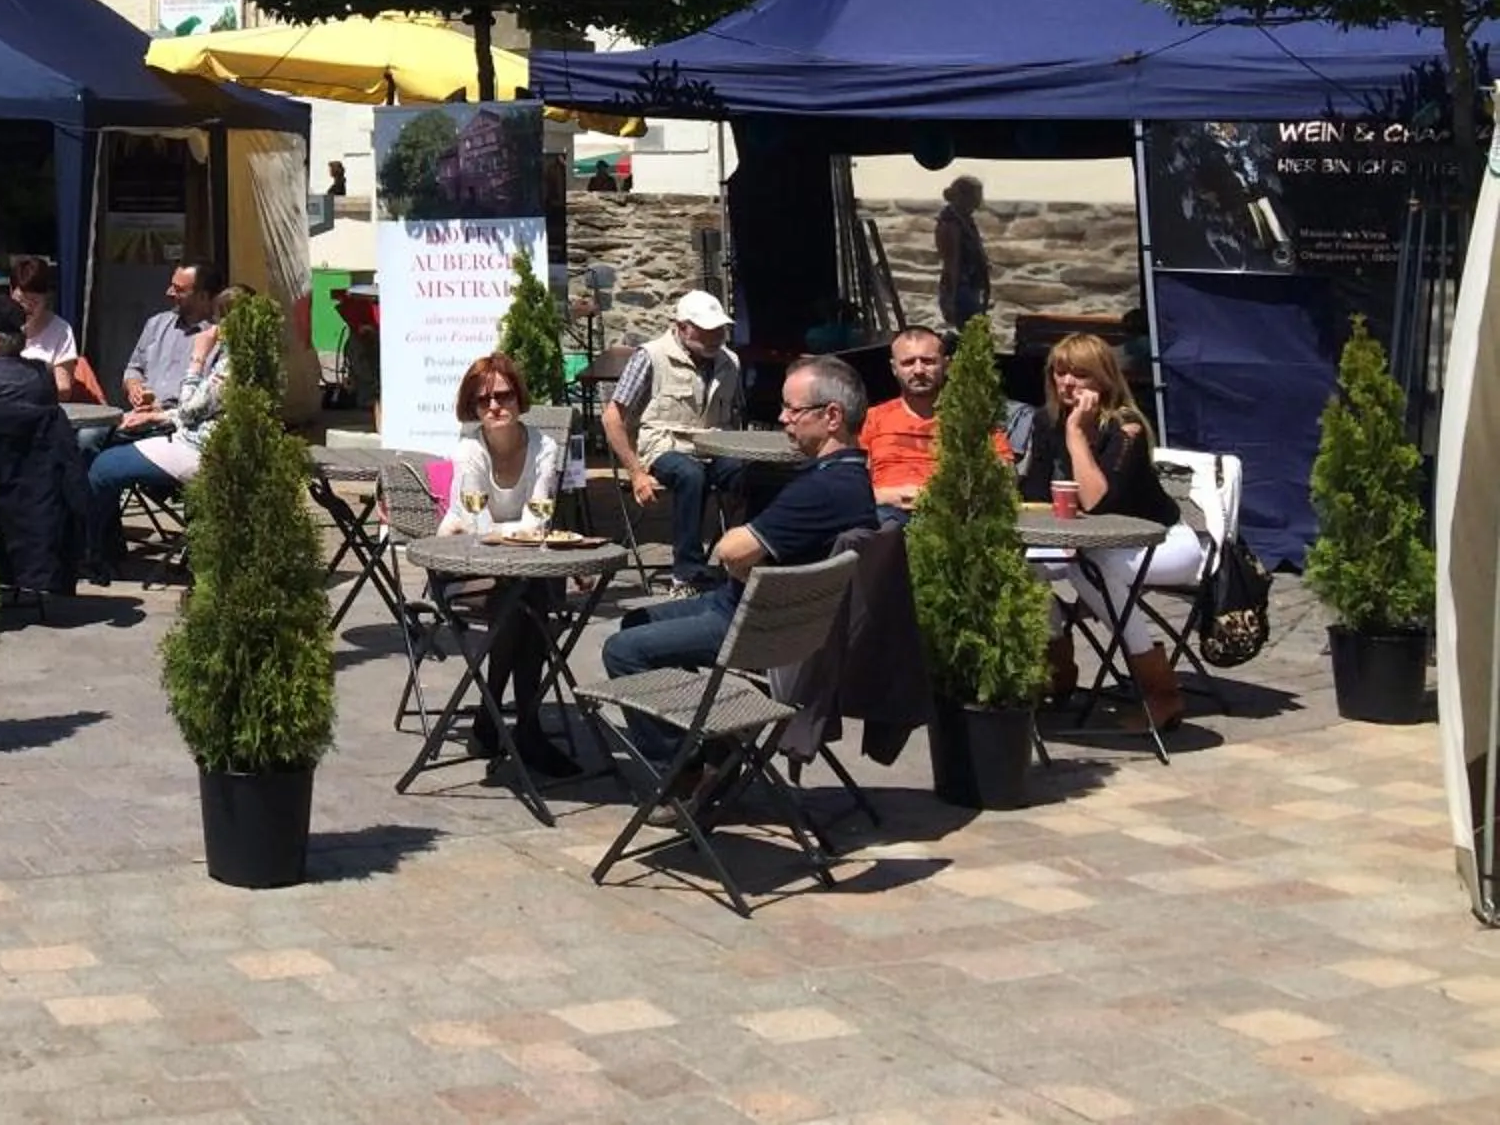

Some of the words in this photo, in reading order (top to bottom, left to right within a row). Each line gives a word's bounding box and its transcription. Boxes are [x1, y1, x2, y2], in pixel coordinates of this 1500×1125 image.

[1278, 120, 1345, 143] WEIN
[1353, 122, 1376, 143] &
[1276, 157, 1317, 174] HIER
[1321, 158, 1352, 174] BIN
